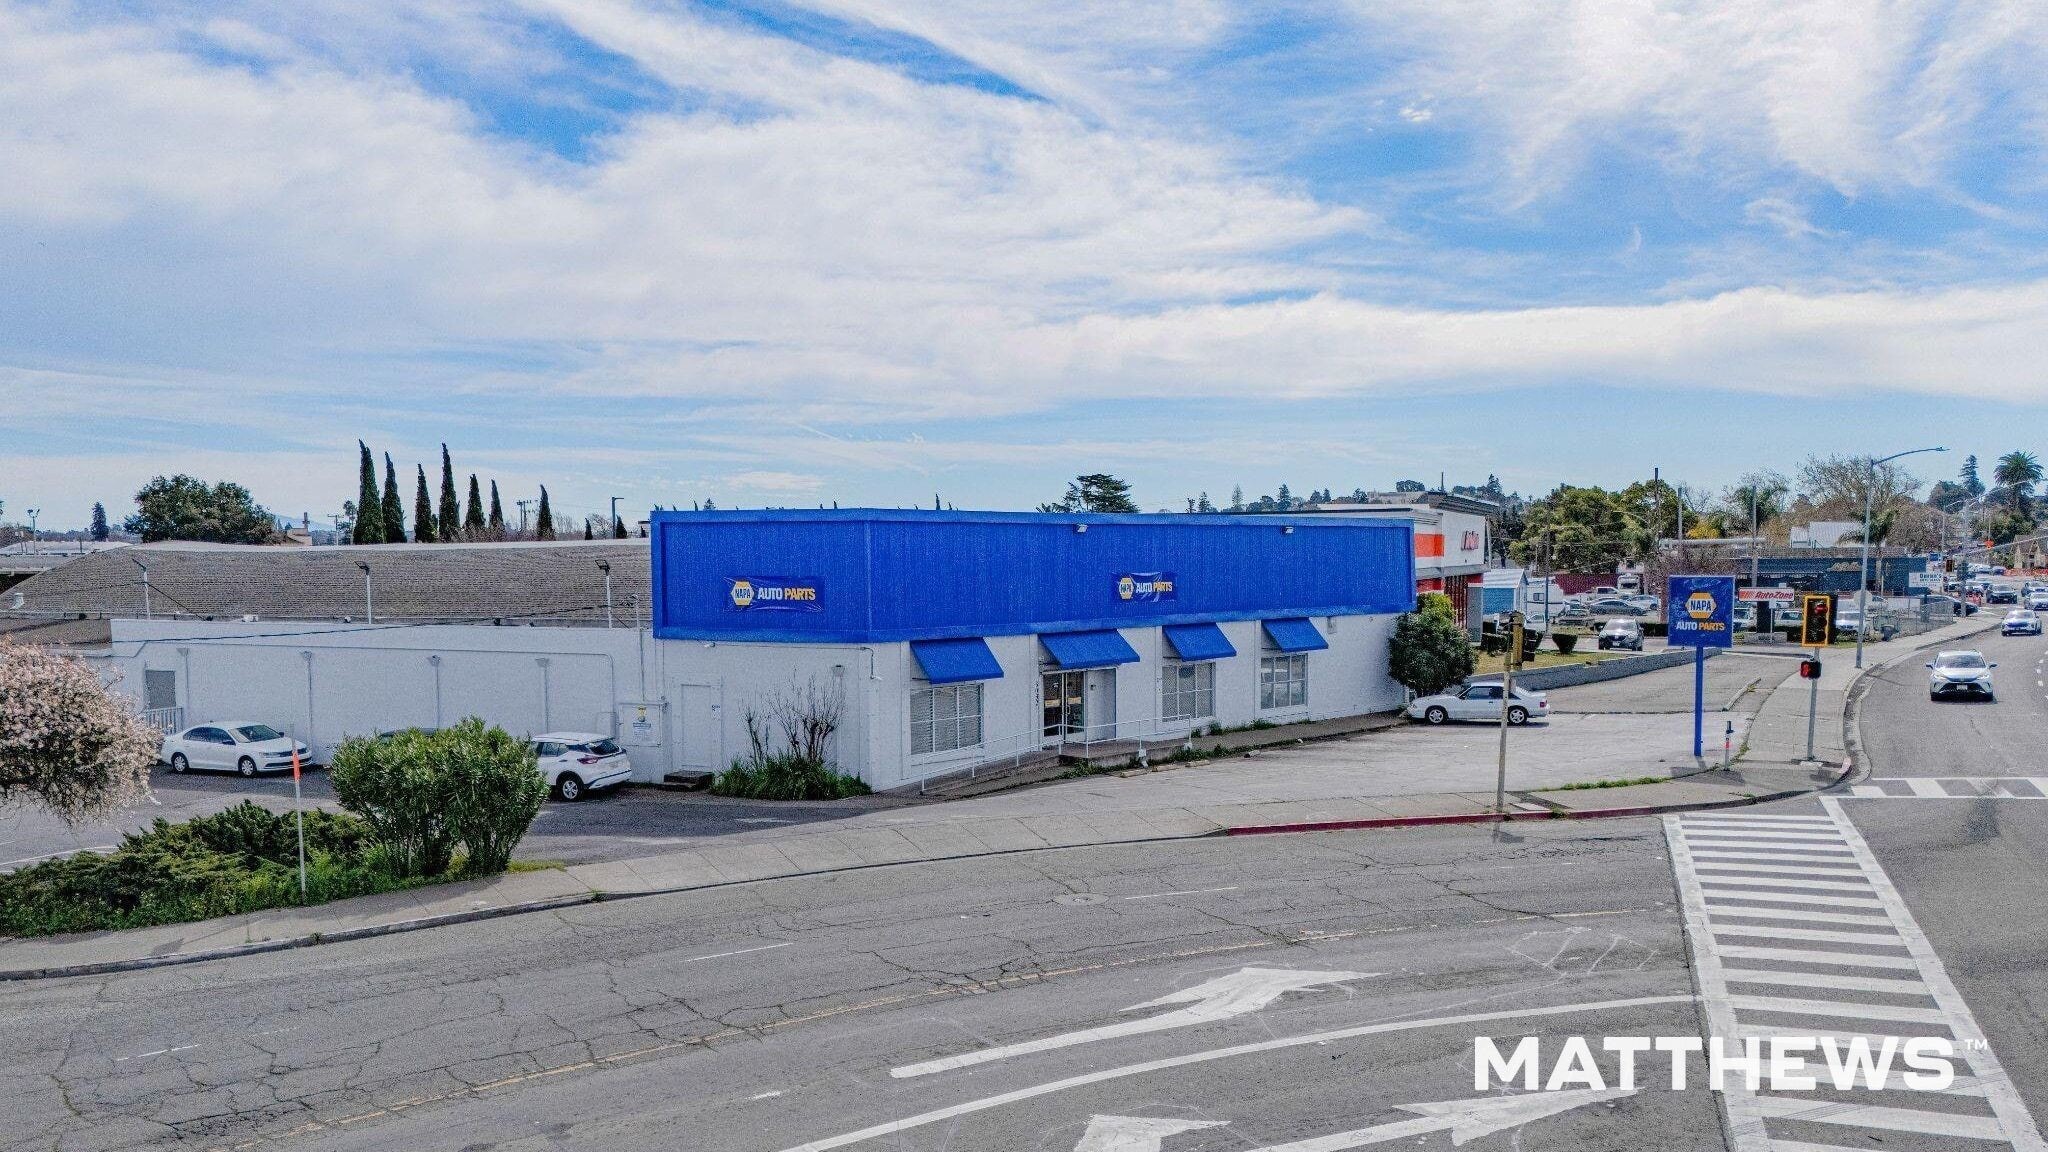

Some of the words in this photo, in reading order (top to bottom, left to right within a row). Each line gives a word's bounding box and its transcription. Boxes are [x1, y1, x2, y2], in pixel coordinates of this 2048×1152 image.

[1136, 582, 1152, 593] AUTO
[1153, 581, 1173, 592] PARTS
[735, 588, 751, 598] NAPA
[757, 587, 783, 600] AUTO
[784, 587, 816, 600] PARTS
[1690, 600, 1711, 611] NAPA
[1676, 622, 1697, 631] AUTO
[1698, 622, 1725, 631] PARTS
